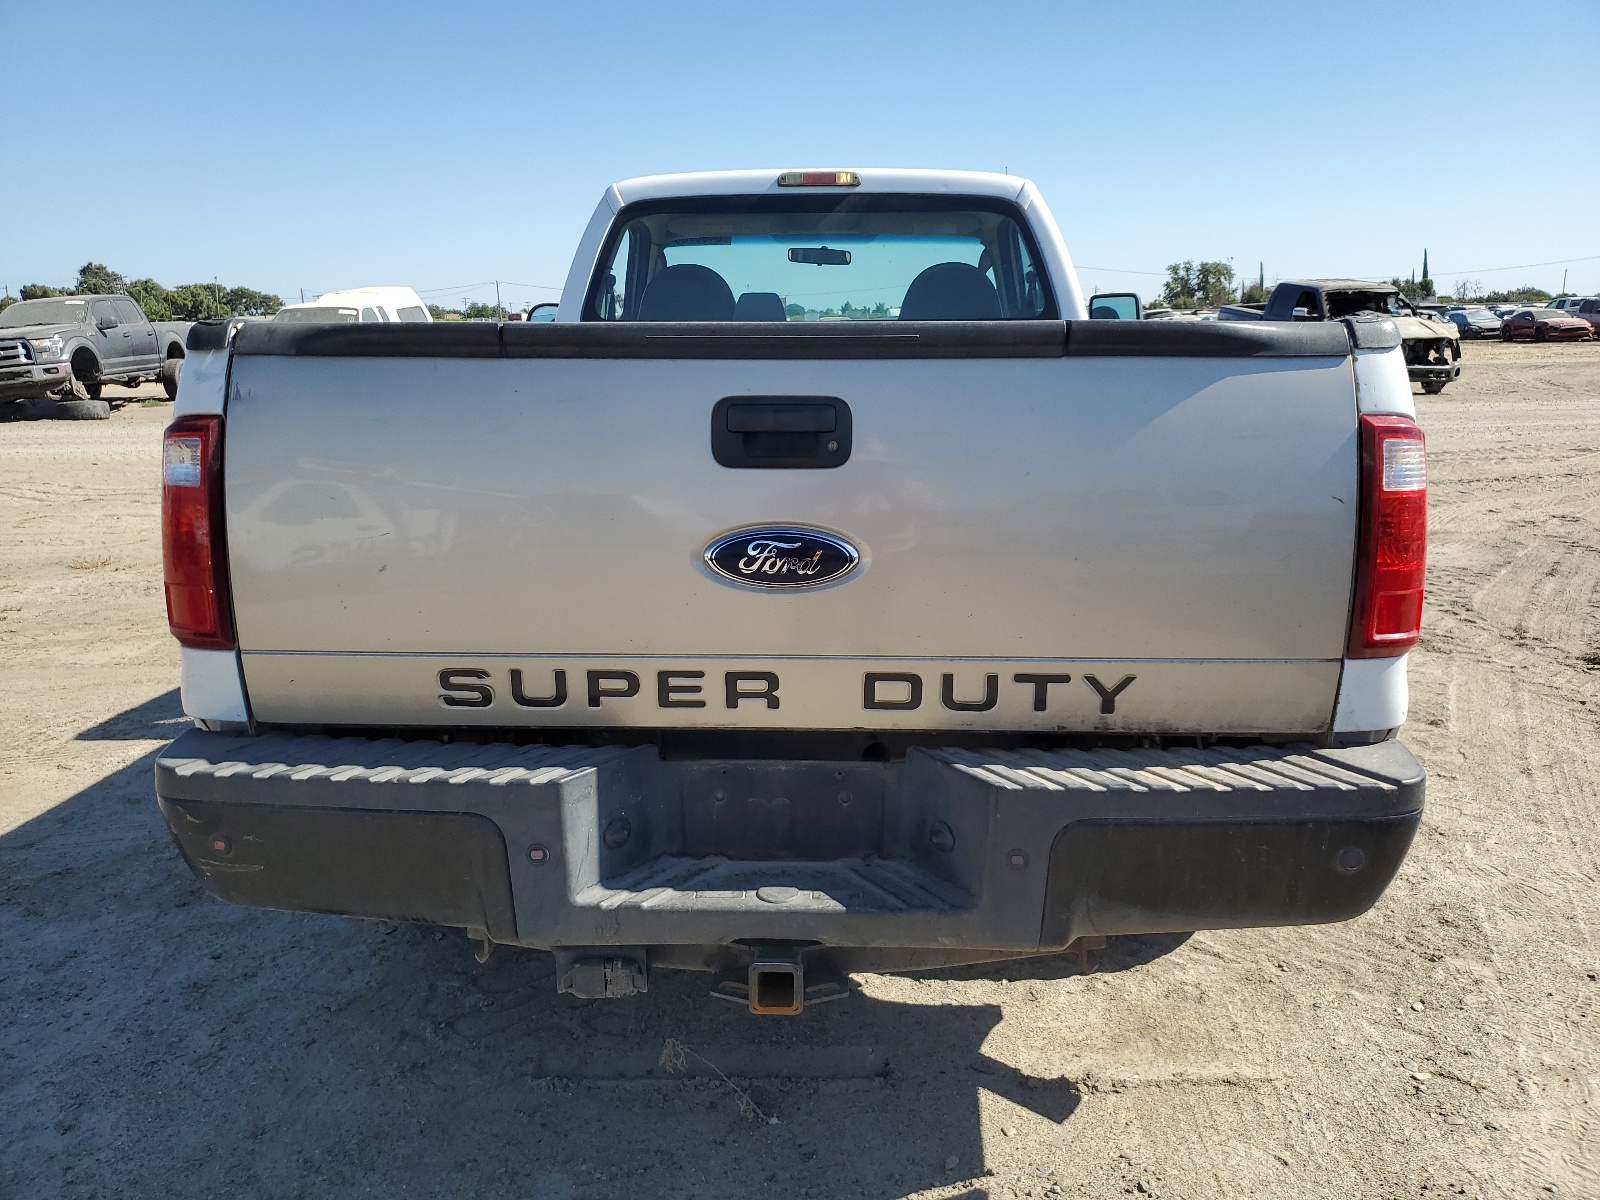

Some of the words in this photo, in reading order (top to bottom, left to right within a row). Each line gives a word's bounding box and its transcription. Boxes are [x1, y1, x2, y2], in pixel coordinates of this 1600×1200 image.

[738, 540, 823, 575] Ford
[437, 668, 780, 710] SUPER
[862, 671, 1138, 715] DUTY
